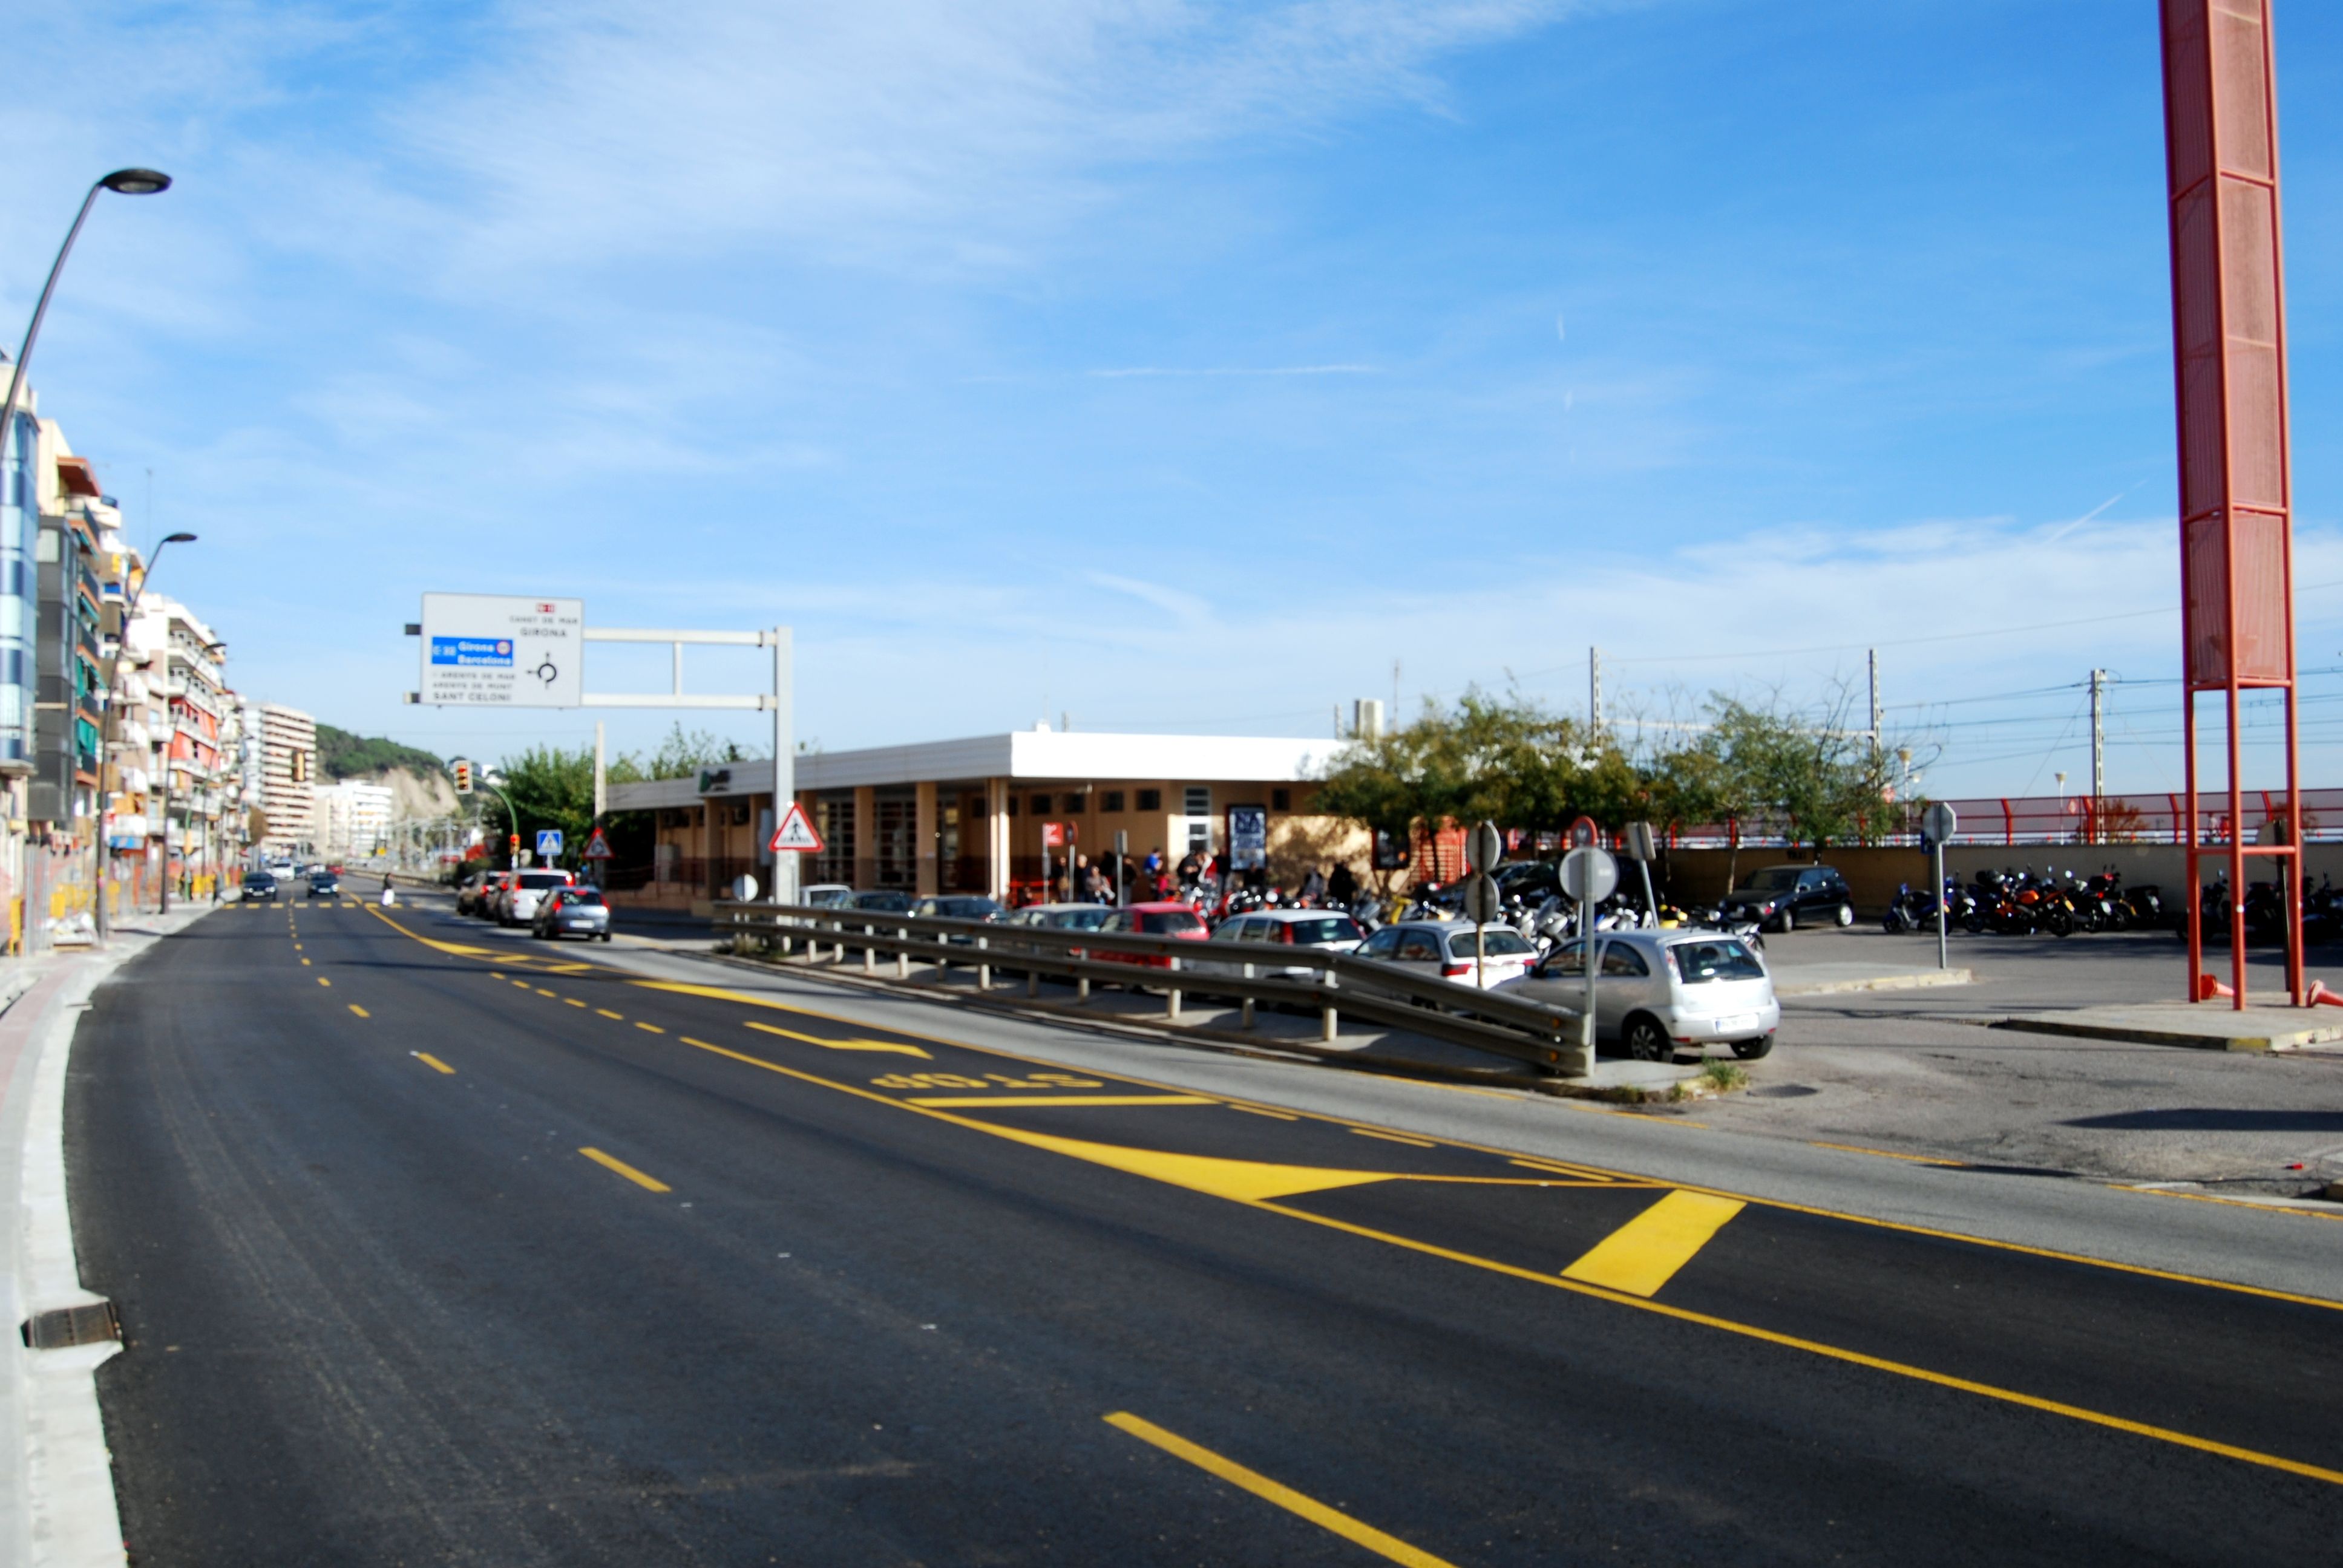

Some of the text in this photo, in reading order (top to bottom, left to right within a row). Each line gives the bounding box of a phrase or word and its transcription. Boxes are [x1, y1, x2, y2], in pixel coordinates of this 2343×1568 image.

[520, 627, 567, 638] GIRONA
[457, 641, 495, 652] Girona
[457, 653, 512, 665] Barcelona
[433, 691, 511, 702] SANT CELONI
